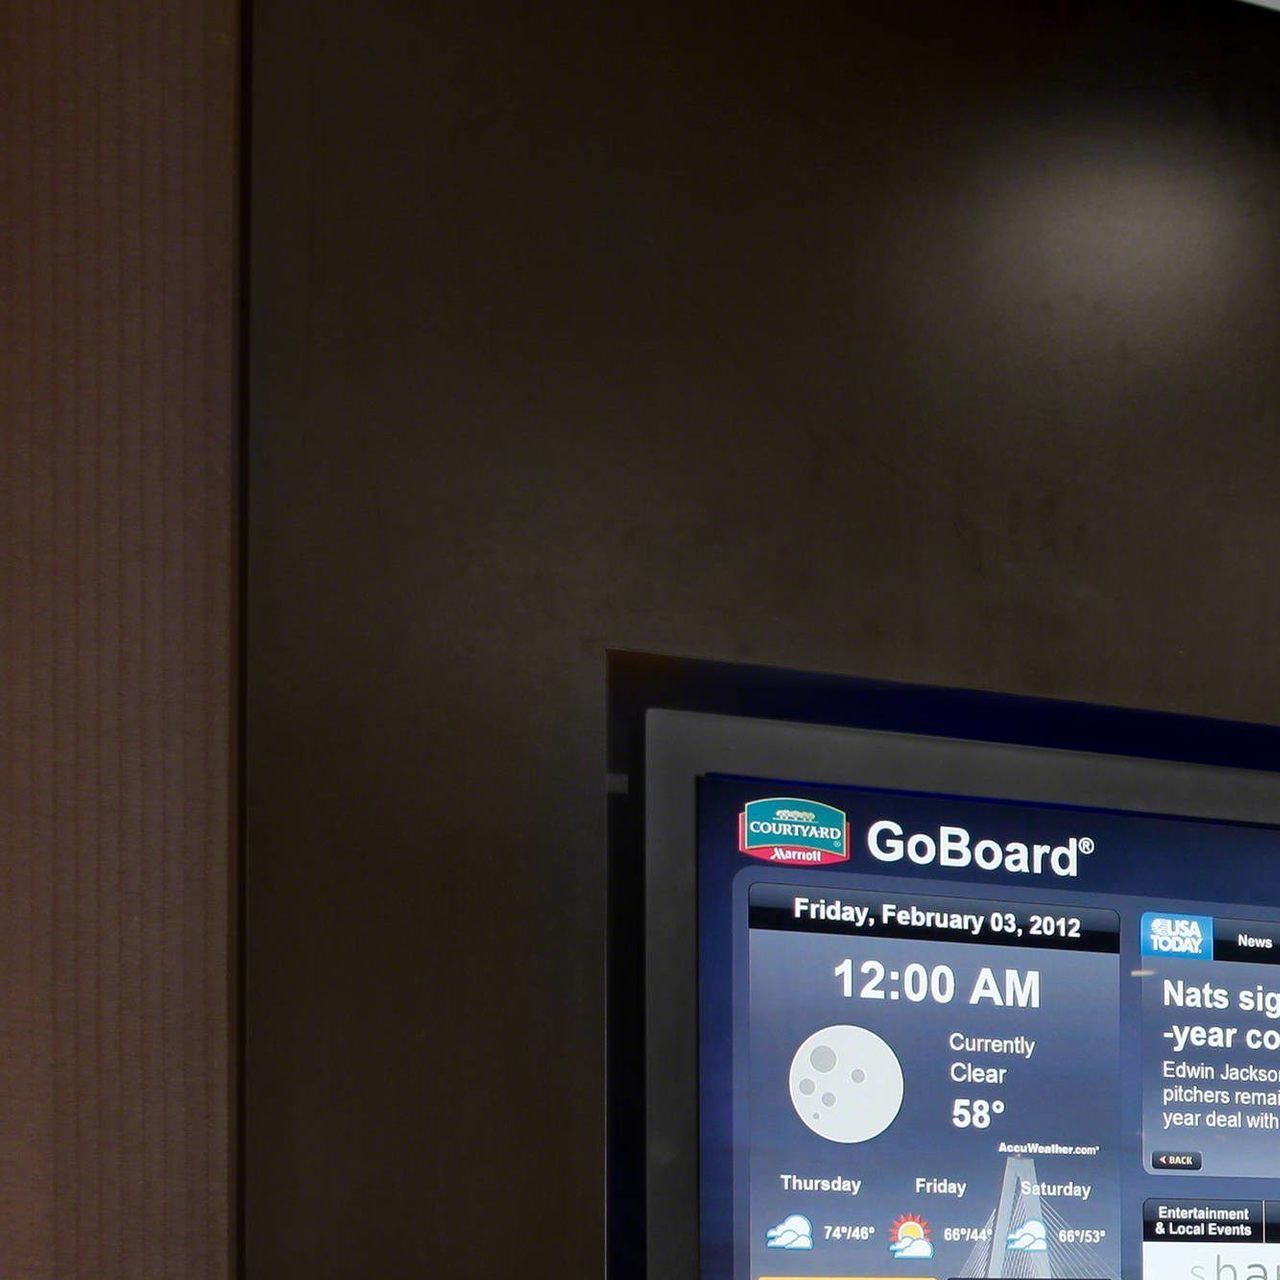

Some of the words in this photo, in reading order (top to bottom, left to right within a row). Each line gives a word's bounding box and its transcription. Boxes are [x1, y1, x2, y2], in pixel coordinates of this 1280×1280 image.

[750, 821, 841, 840] COURTYARD
[770, 847, 822, 862] Marriott
[794, 898, 875, 927] Friday,
[883, 905, 984, 935] February
[990, 912, 1022, 937] 03,
[1029, 916, 1081, 938] 2012
[1167, 919, 1199, 936] USA
[1237, 934, 1273, 949] News
[834, 959, 955, 1003] 12:00
[969, 968, 1041, 1008] AM
[1163, 979, 1230, 1009] Nats
[949, 1032, 1035, 1059] Currently
[951, 1063, 1007, 1084] Clear
[1163, 1060, 1215, 1080] Edwin
[1163, 1085, 1230, 1105] pitchers
[1163, 1111, 1201, 1129] year
[1206, 1110, 1241, 1128] deal
[1246, 1112, 1279, 1130] with
[1169, 1156, 1193, 1165] BACK
[780, 1174, 861, 1195] Thursday
[915, 1178, 967, 1197] Friday
[1021, 1181, 1091, 1200] Saturday
[1158, 1206, 1249, 1221] Entertainment
[1155, 1222, 1166, 1235] &
[1169, 1222, 1205, 1235] Local
[1208, 1222, 1252, 1236] Events
